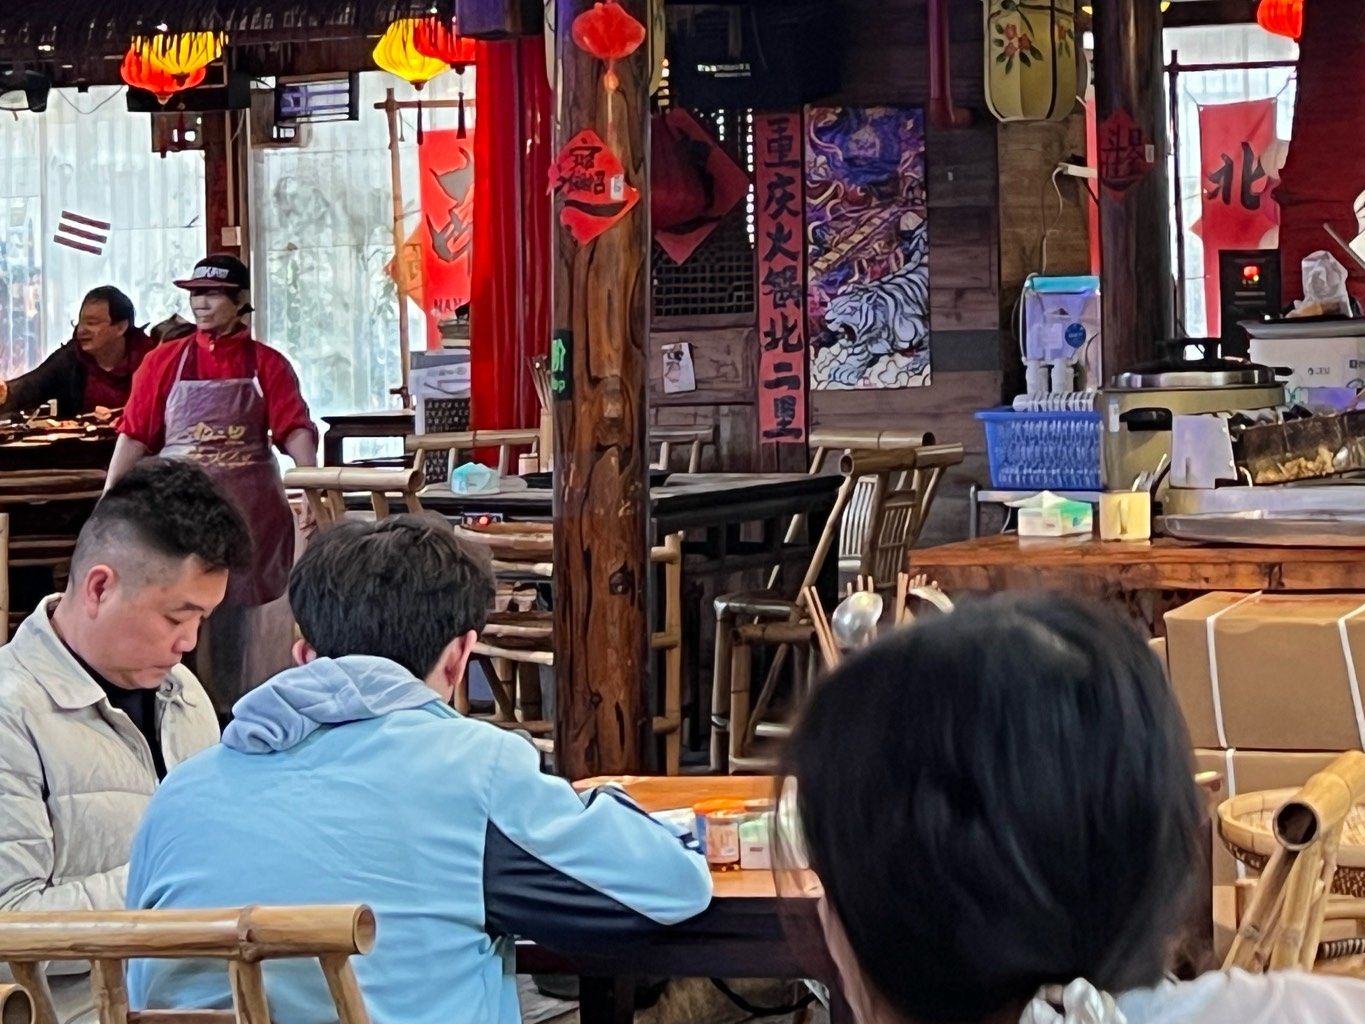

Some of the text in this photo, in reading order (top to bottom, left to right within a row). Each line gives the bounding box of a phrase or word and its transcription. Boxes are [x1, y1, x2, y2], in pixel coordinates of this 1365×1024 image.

[1207, 141, 1266, 210] 北
[762, 117, 806, 441] 重庆火锅北二里
